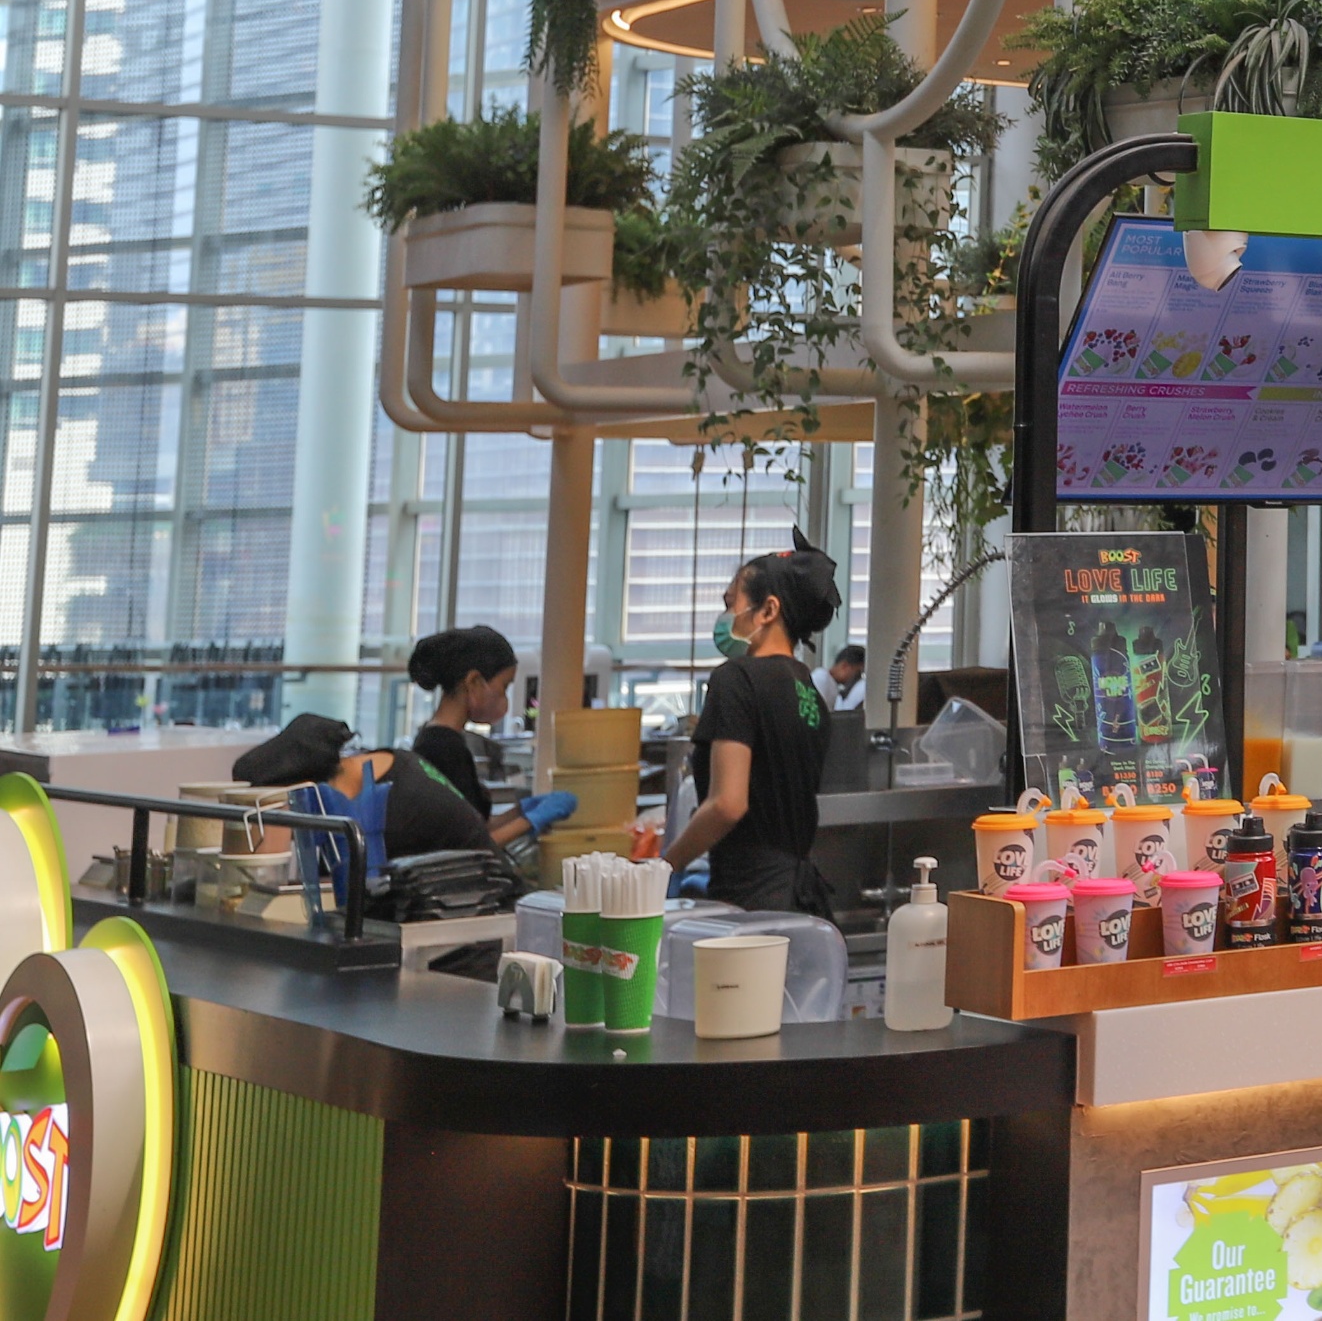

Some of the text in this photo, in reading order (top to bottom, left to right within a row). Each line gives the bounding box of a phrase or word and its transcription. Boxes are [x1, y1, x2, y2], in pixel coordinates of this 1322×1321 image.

[1124, 234, 1163, 246] MOST
[1121, 244, 1183, 257] POPULAR
[1067, 383, 1146, 396] REFRESHING
[1149, 385, 1206, 397] CRUSHES
[1099, 548, 1141, 565] BOOST
[1064, 568, 1178, 592] LOVE LIFE
[1090, 594, 1118, 604] GLOWS
[999, 866, 1023, 877] LIFE
[1182, 905, 1217, 928] LOVE
[1193, 923, 1214, 938] LIFE
[1254, 933, 1271, 941] Flask
[1043, 938, 1062, 952] LIFE
[0, 1103, 70, 1251] OST
[1211, 1240, 1245, 1270] Our
[1180, 1268, 1276, 1305] Guarantee
[1205, 1307, 1246, 1321] promise
